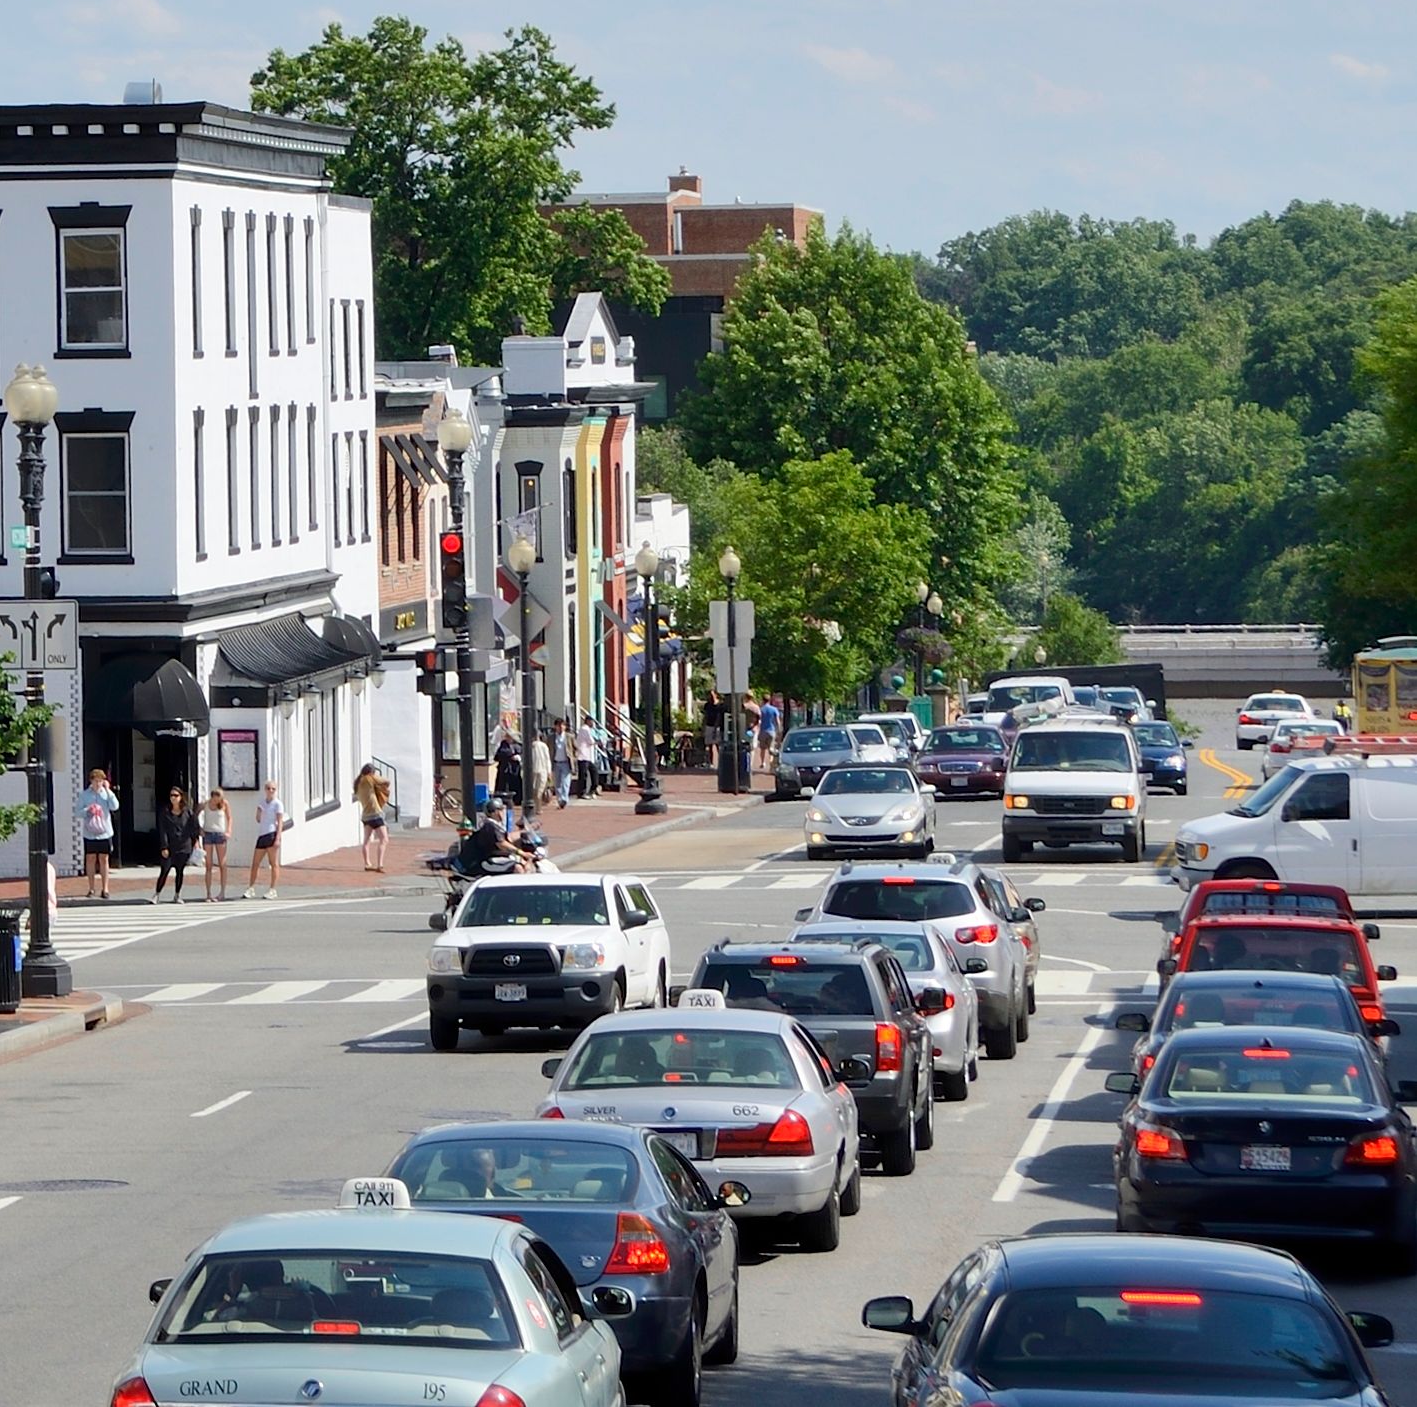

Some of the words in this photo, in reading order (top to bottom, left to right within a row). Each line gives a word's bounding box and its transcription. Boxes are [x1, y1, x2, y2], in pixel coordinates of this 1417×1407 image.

[47, 654, 67, 664] ONLY
[688, 997, 715, 1007] TAXI
[583, 1106, 616, 1115] SILVER
[732, 1105, 759, 1116] 662
[379, 1182, 394, 1191] 911
[354, 1192, 394, 1206] TAXI
[179, 1379, 238, 1397] GRAND
[423, 1382, 446, 1402] 195
